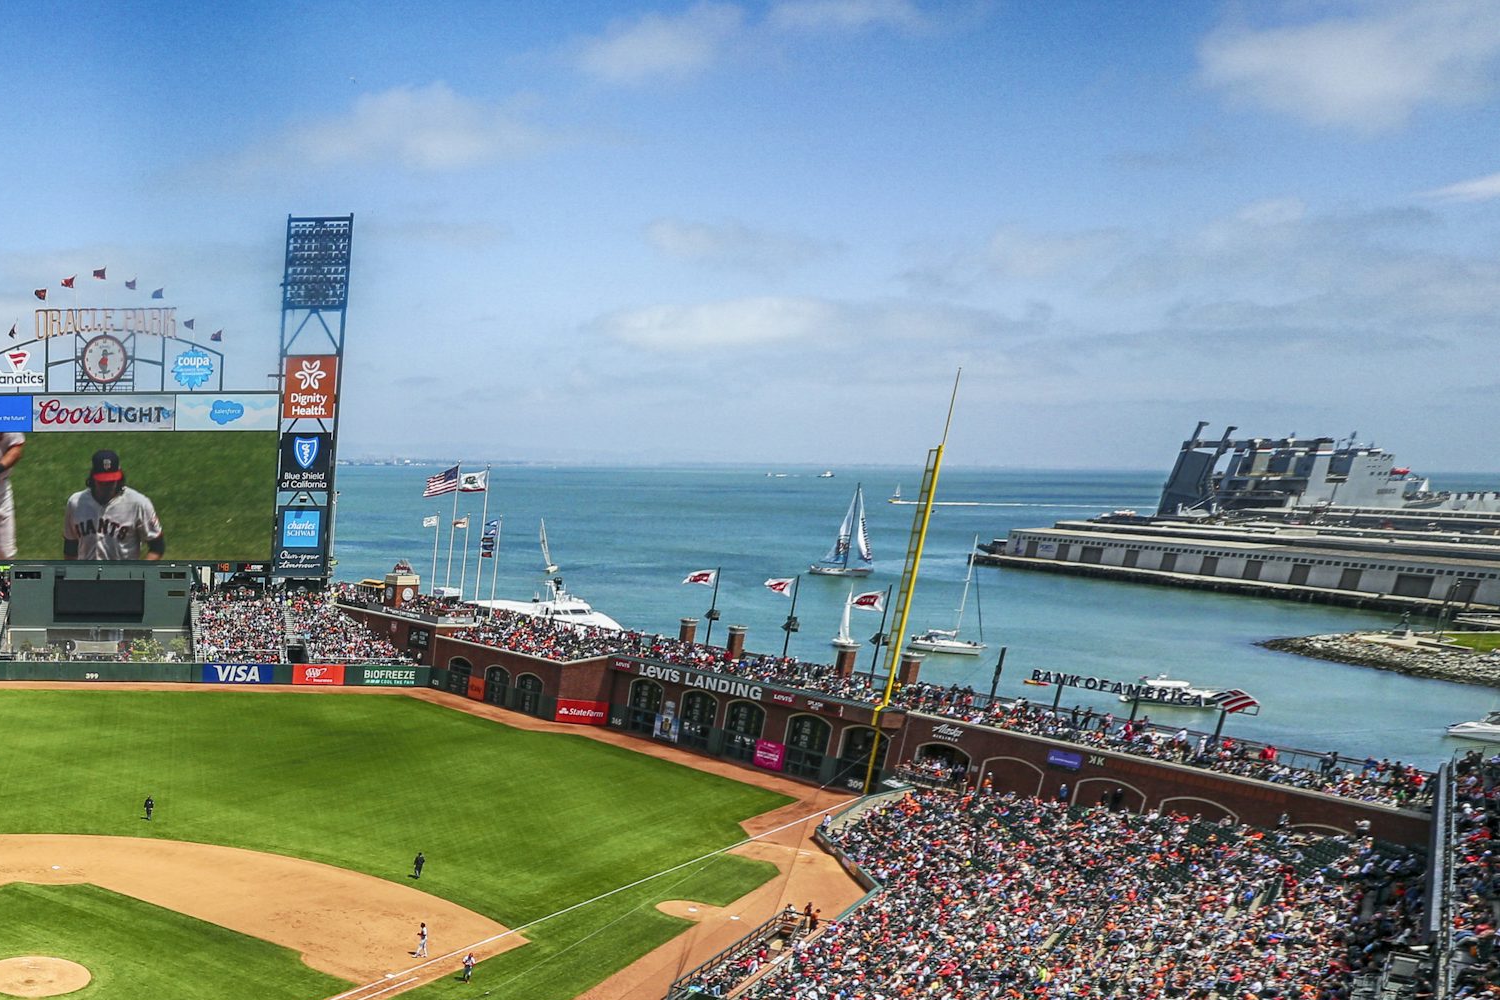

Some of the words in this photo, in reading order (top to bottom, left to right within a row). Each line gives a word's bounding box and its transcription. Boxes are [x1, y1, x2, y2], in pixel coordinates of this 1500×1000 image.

[35, 308, 114, 340] ORACLE
[123, 307, 178, 340] PARK
[178, 356, 210, 368] coupa
[290, 392, 328, 406] Dignity
[39, 399, 105, 425] Coors
[107, 406, 163, 423] LIGHT
[214, 408, 241, 416] salesforce
[284, 472, 301, 480] Blue
[302, 471, 325, 480] Shield
[281, 480, 290, 489] of
[290, 480, 327, 489] California
[287, 521, 315, 530] charles
[85, 672, 99, 680] 399
[213, 665, 260, 682] VISA
[363, 670, 416, 680] BIOFREEZE
[684, 672, 763, 701] LANDING
[1031, 668, 1080, 687] BANK
[1084, 676, 1109, 691] OF
[1111, 681, 1204, 707] AMERICA
[612, 716, 622, 726] 365
[932, 722, 964, 738] Alaska
[847, 778, 864, 790] 309
